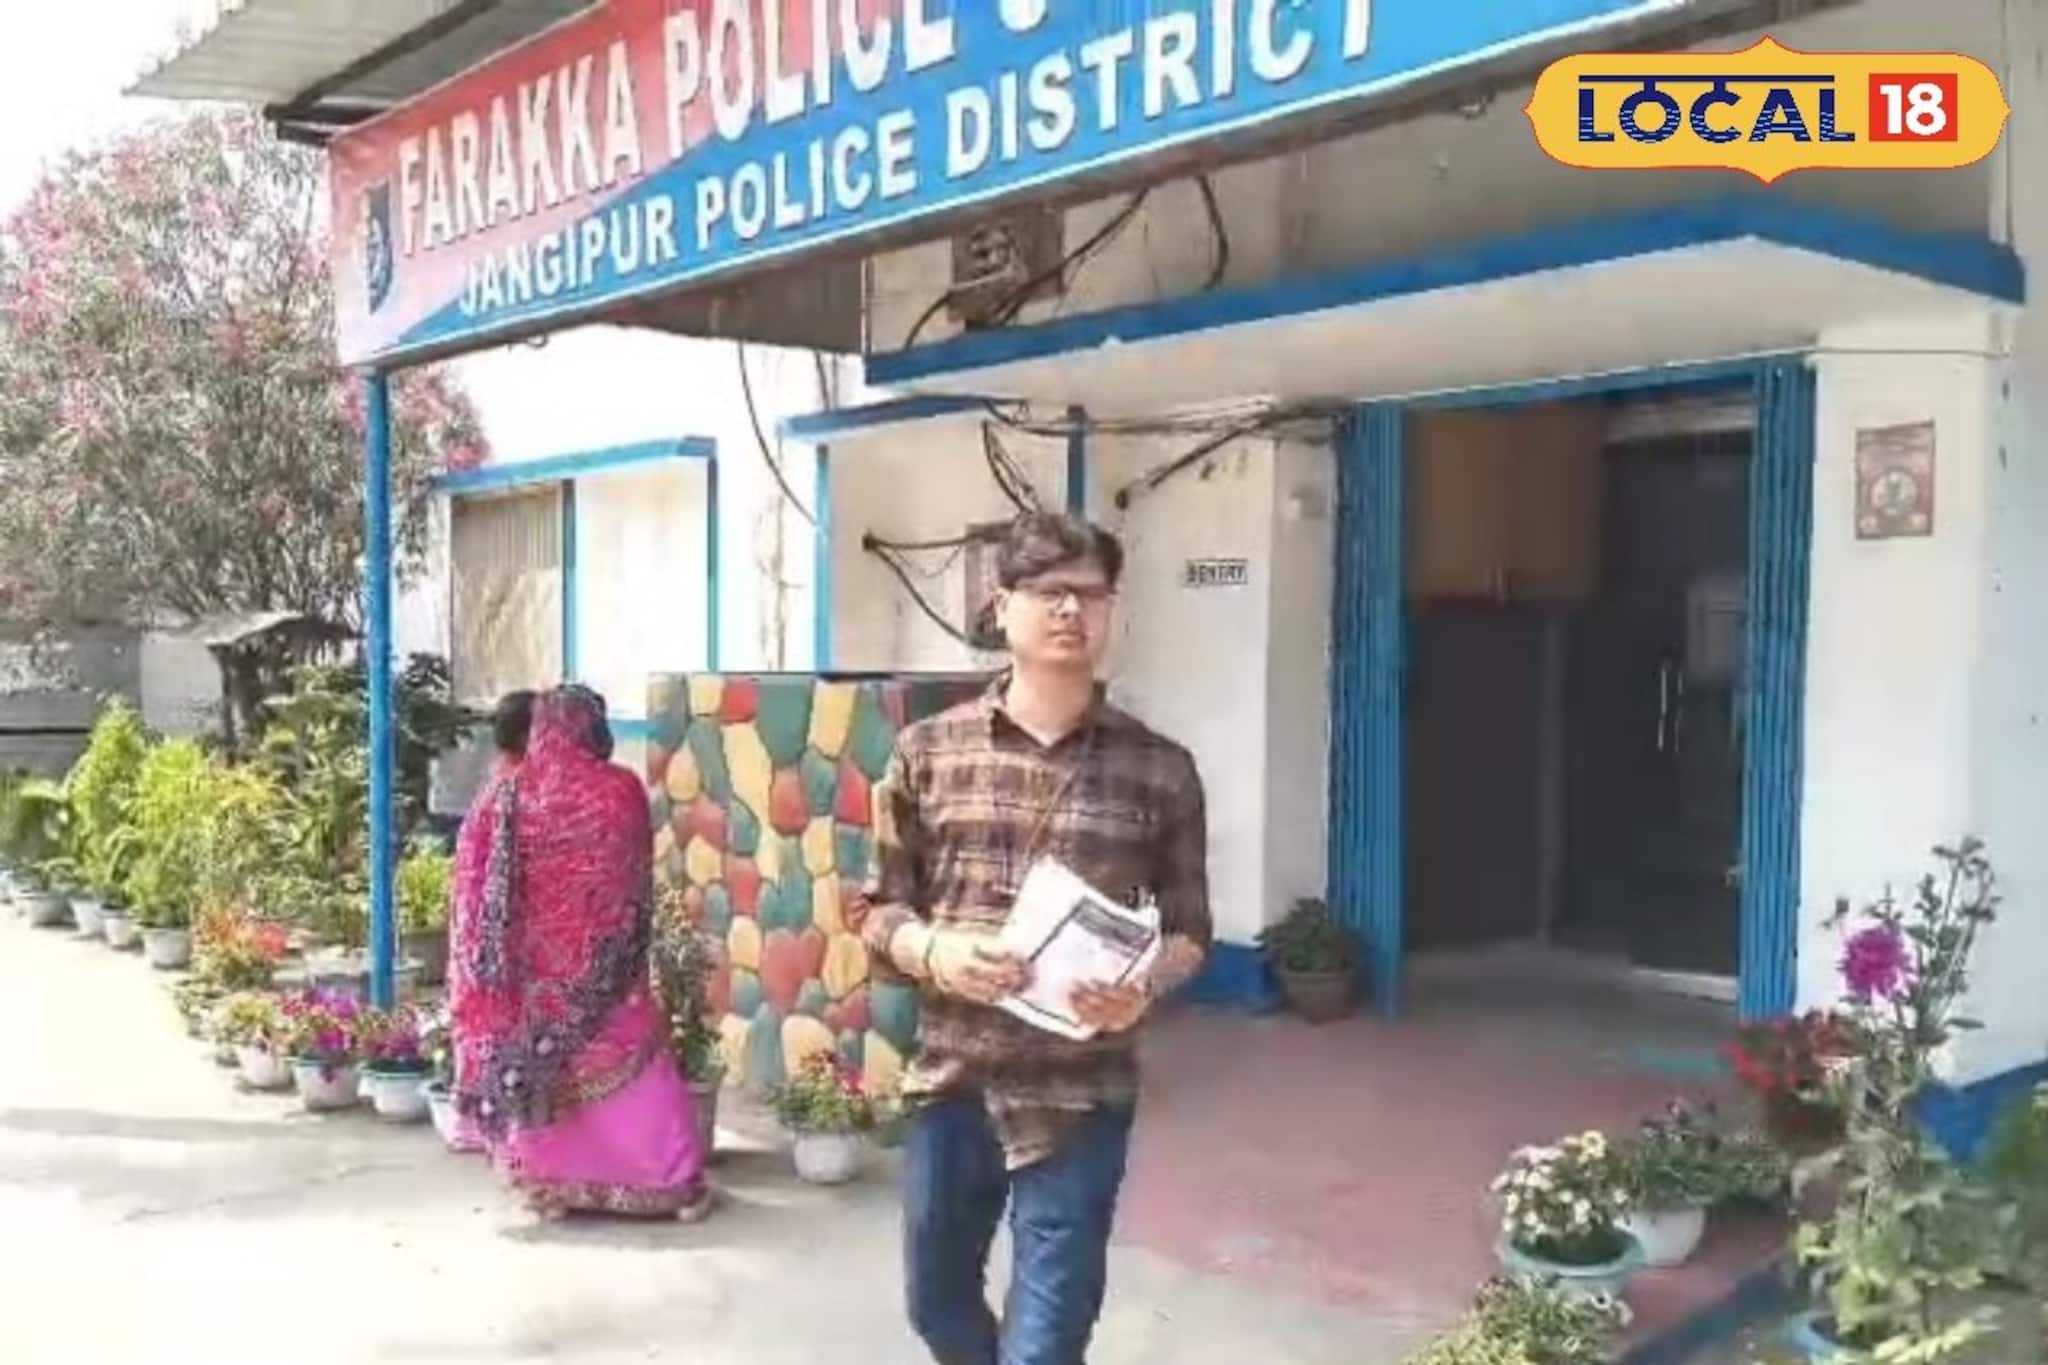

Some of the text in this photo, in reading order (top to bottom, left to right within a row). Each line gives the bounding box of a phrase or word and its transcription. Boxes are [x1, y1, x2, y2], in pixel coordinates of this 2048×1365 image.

[398, 40, 643, 256] FARAKKA
[459, 196, 678, 316] JANGIPUR
[696, 109, 918, 251] POLICE
